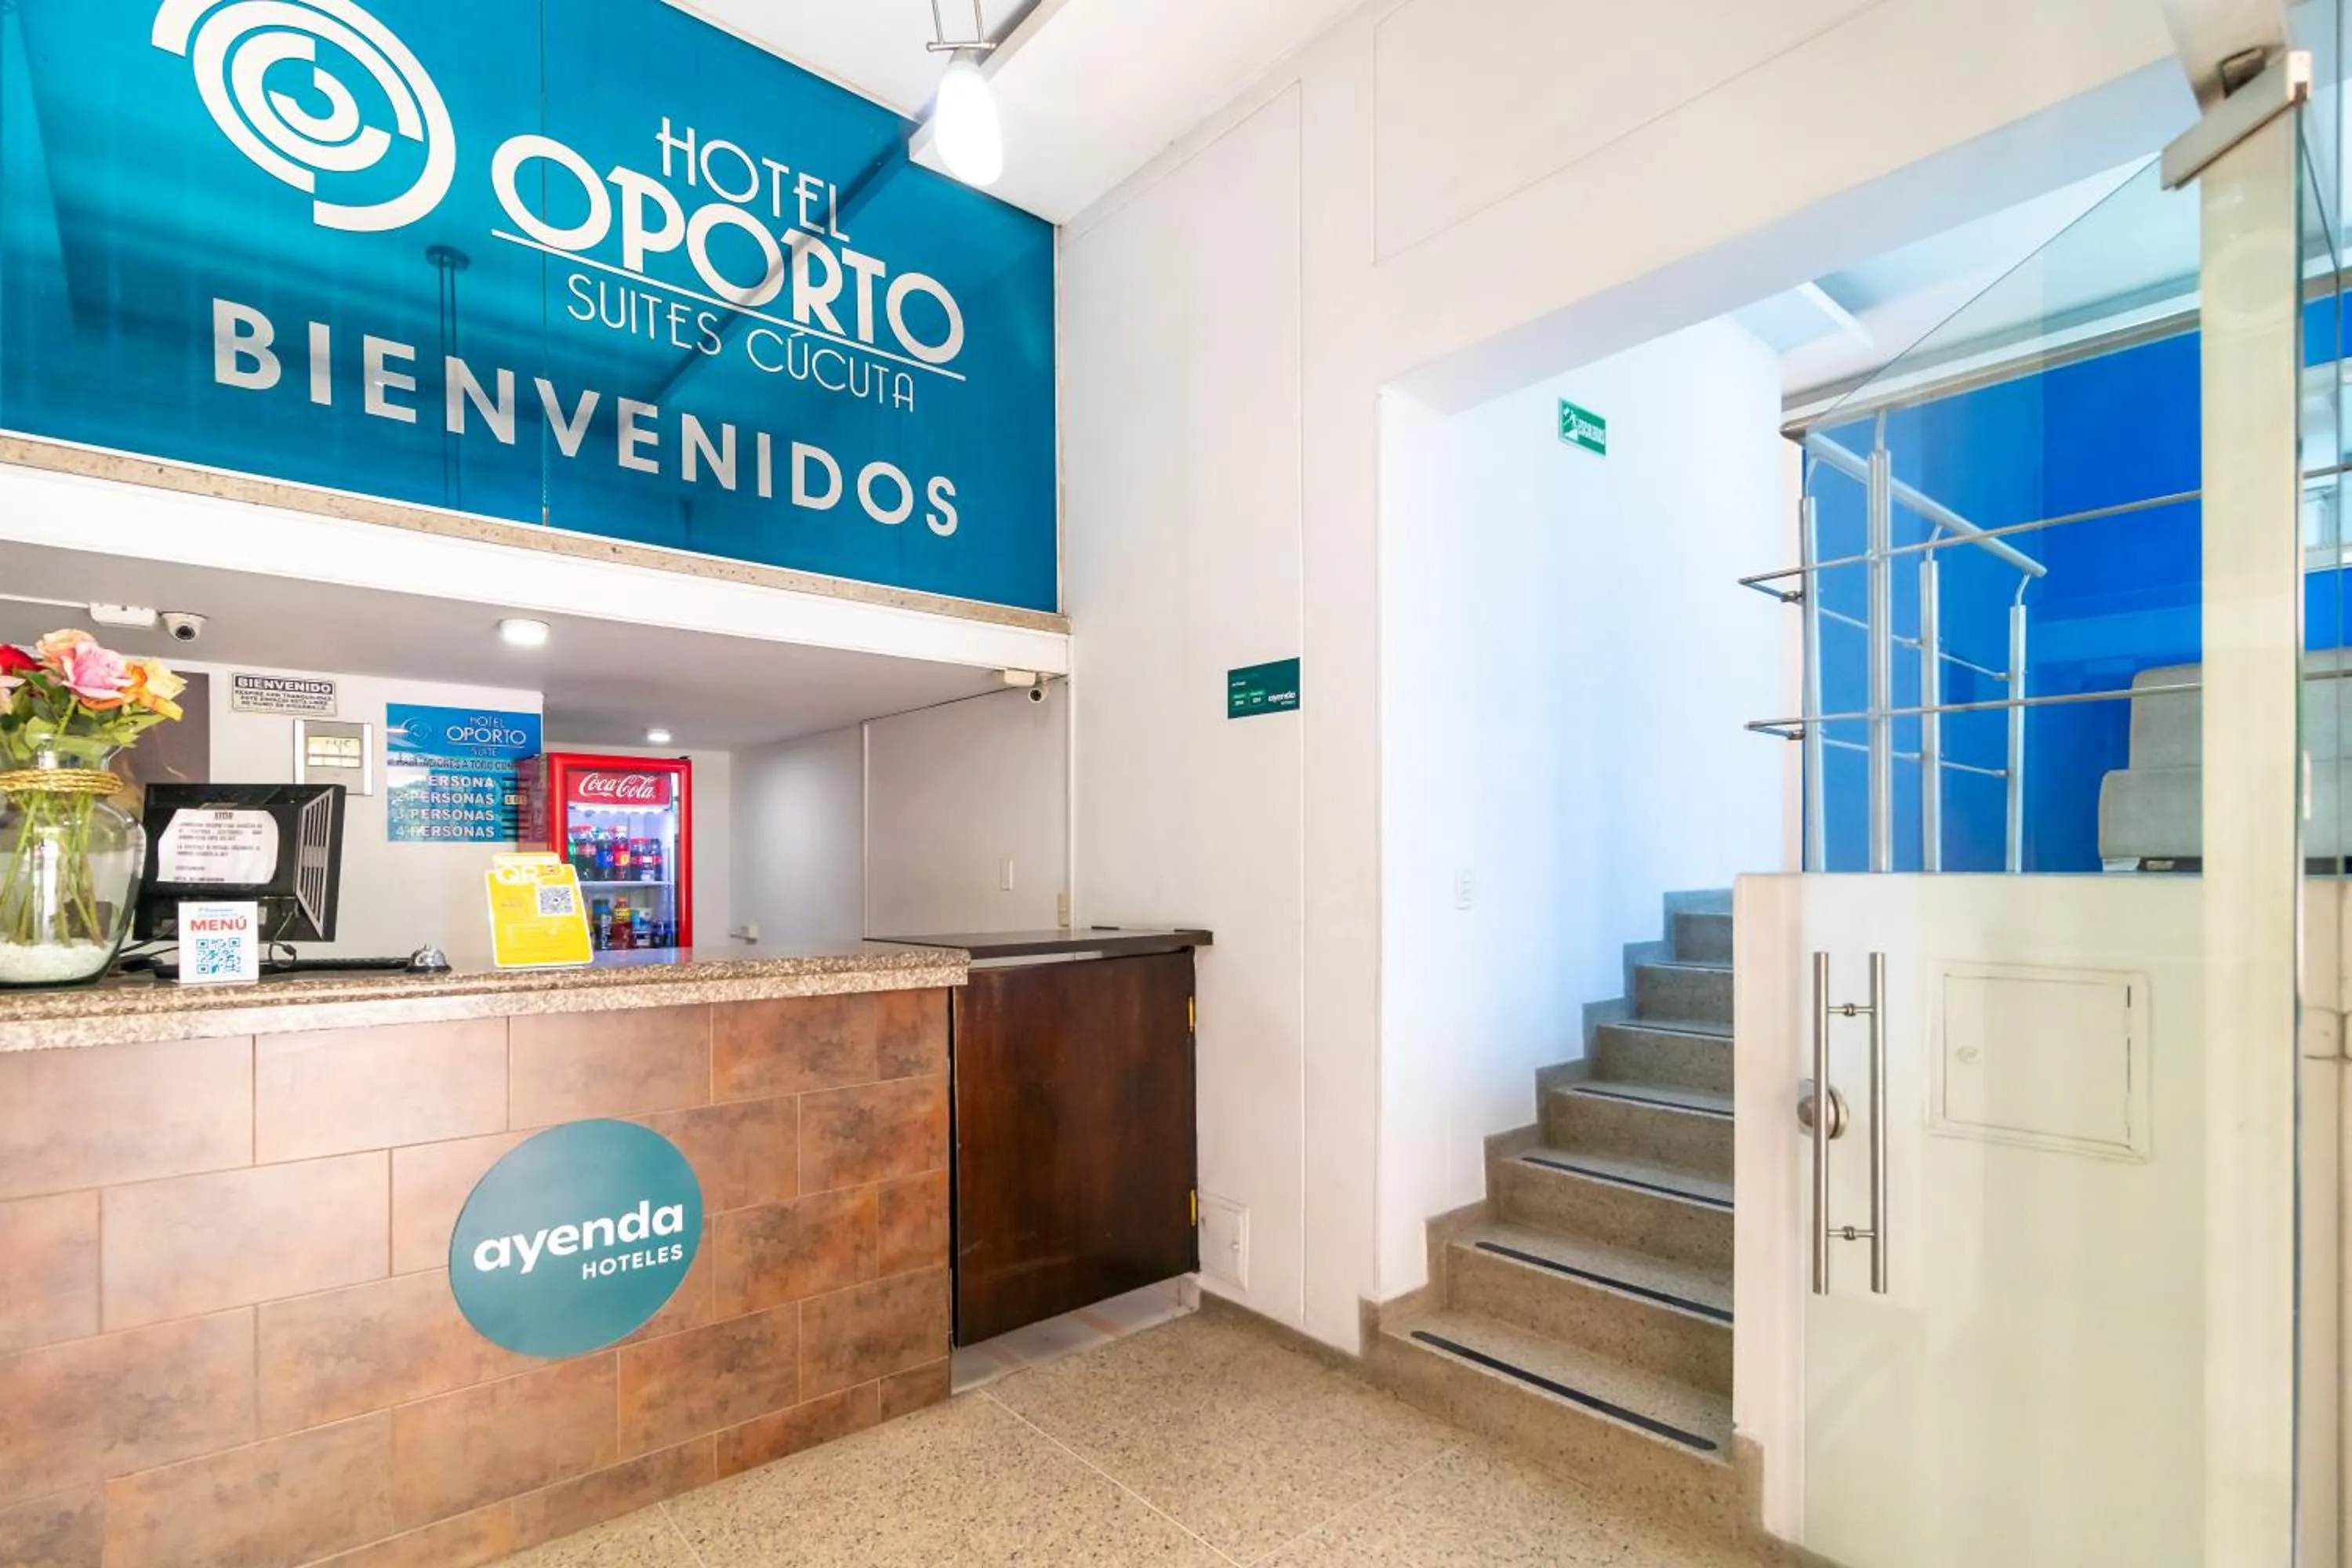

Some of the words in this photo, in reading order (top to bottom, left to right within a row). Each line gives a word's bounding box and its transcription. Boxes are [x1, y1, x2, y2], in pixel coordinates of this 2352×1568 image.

[655, 116, 851, 242] HOTEL
[491, 134, 965, 365] OPORTO
[567, 273, 722, 356] SUITES
[747, 328, 914, 412] CÚCUTA
[213, 297, 958, 537] BIENVENIDOS
[238, 677, 331, 693] BIENVENIDO
[470, 717, 505, 728] HOTEL
[446, 726, 526, 745] OPORTO
[472, 747, 498, 757] SUITE
[428, 775, 495, 788] ERSONA
[579, 772, 655, 799] Coca-Cola
[410, 791, 495, 805] PERSONAS
[410, 808, 495, 821] PERSONAS
[410, 826, 495, 838] PERSONAS
[191, 916, 247, 932] MENÚ
[474, 1200, 683, 1274] ayenda
[583, 1243, 684, 1279] HOTELES
